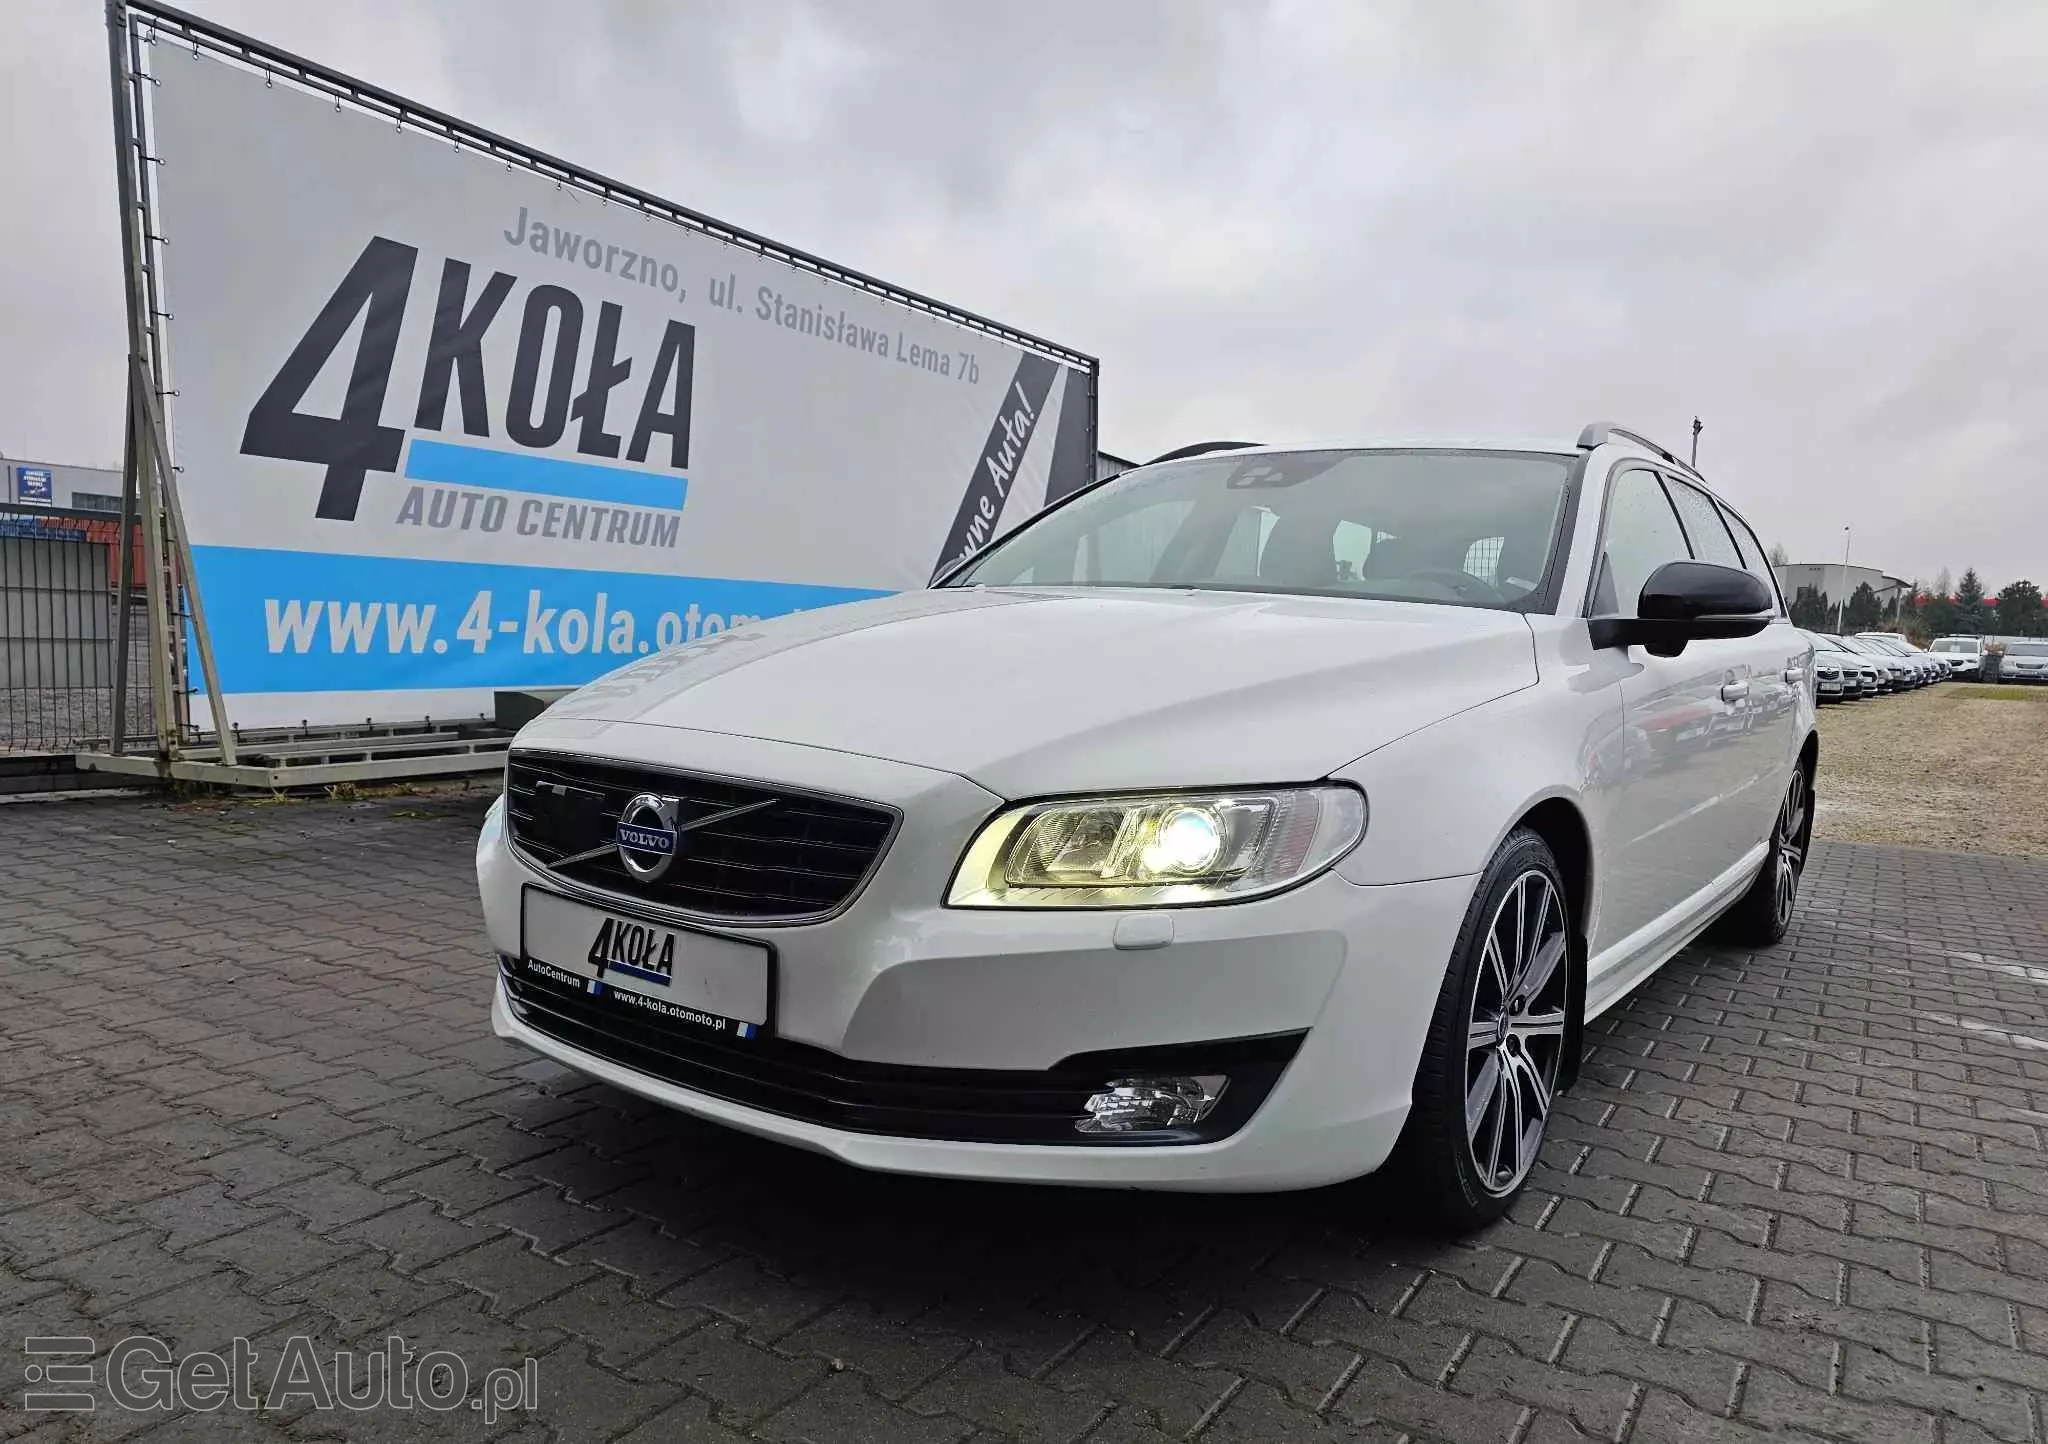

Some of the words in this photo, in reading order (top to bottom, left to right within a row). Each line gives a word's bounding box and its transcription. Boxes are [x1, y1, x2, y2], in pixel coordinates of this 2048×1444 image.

[504, 207, 687, 302] Jaworzno,
[708, 273, 743, 314] ul.
[755, 286, 889, 358] Stanisława
[896, 332, 951, 378] Lema
[957, 351, 980, 385] 7b
[959, 496, 995, 558] wne
[986, 381, 1034, 498] Auta!
[397, 486, 508, 533] AUTO
[516, 501, 681, 549] CENTRUM
[620, 829, 670, 849] VOLVO
[527, 959, 581, 989] AutoCentrum
[587, 917, 676, 979] 4KOŁA
[614, 990, 727, 1030] www.4-kola.otomoto.pl
